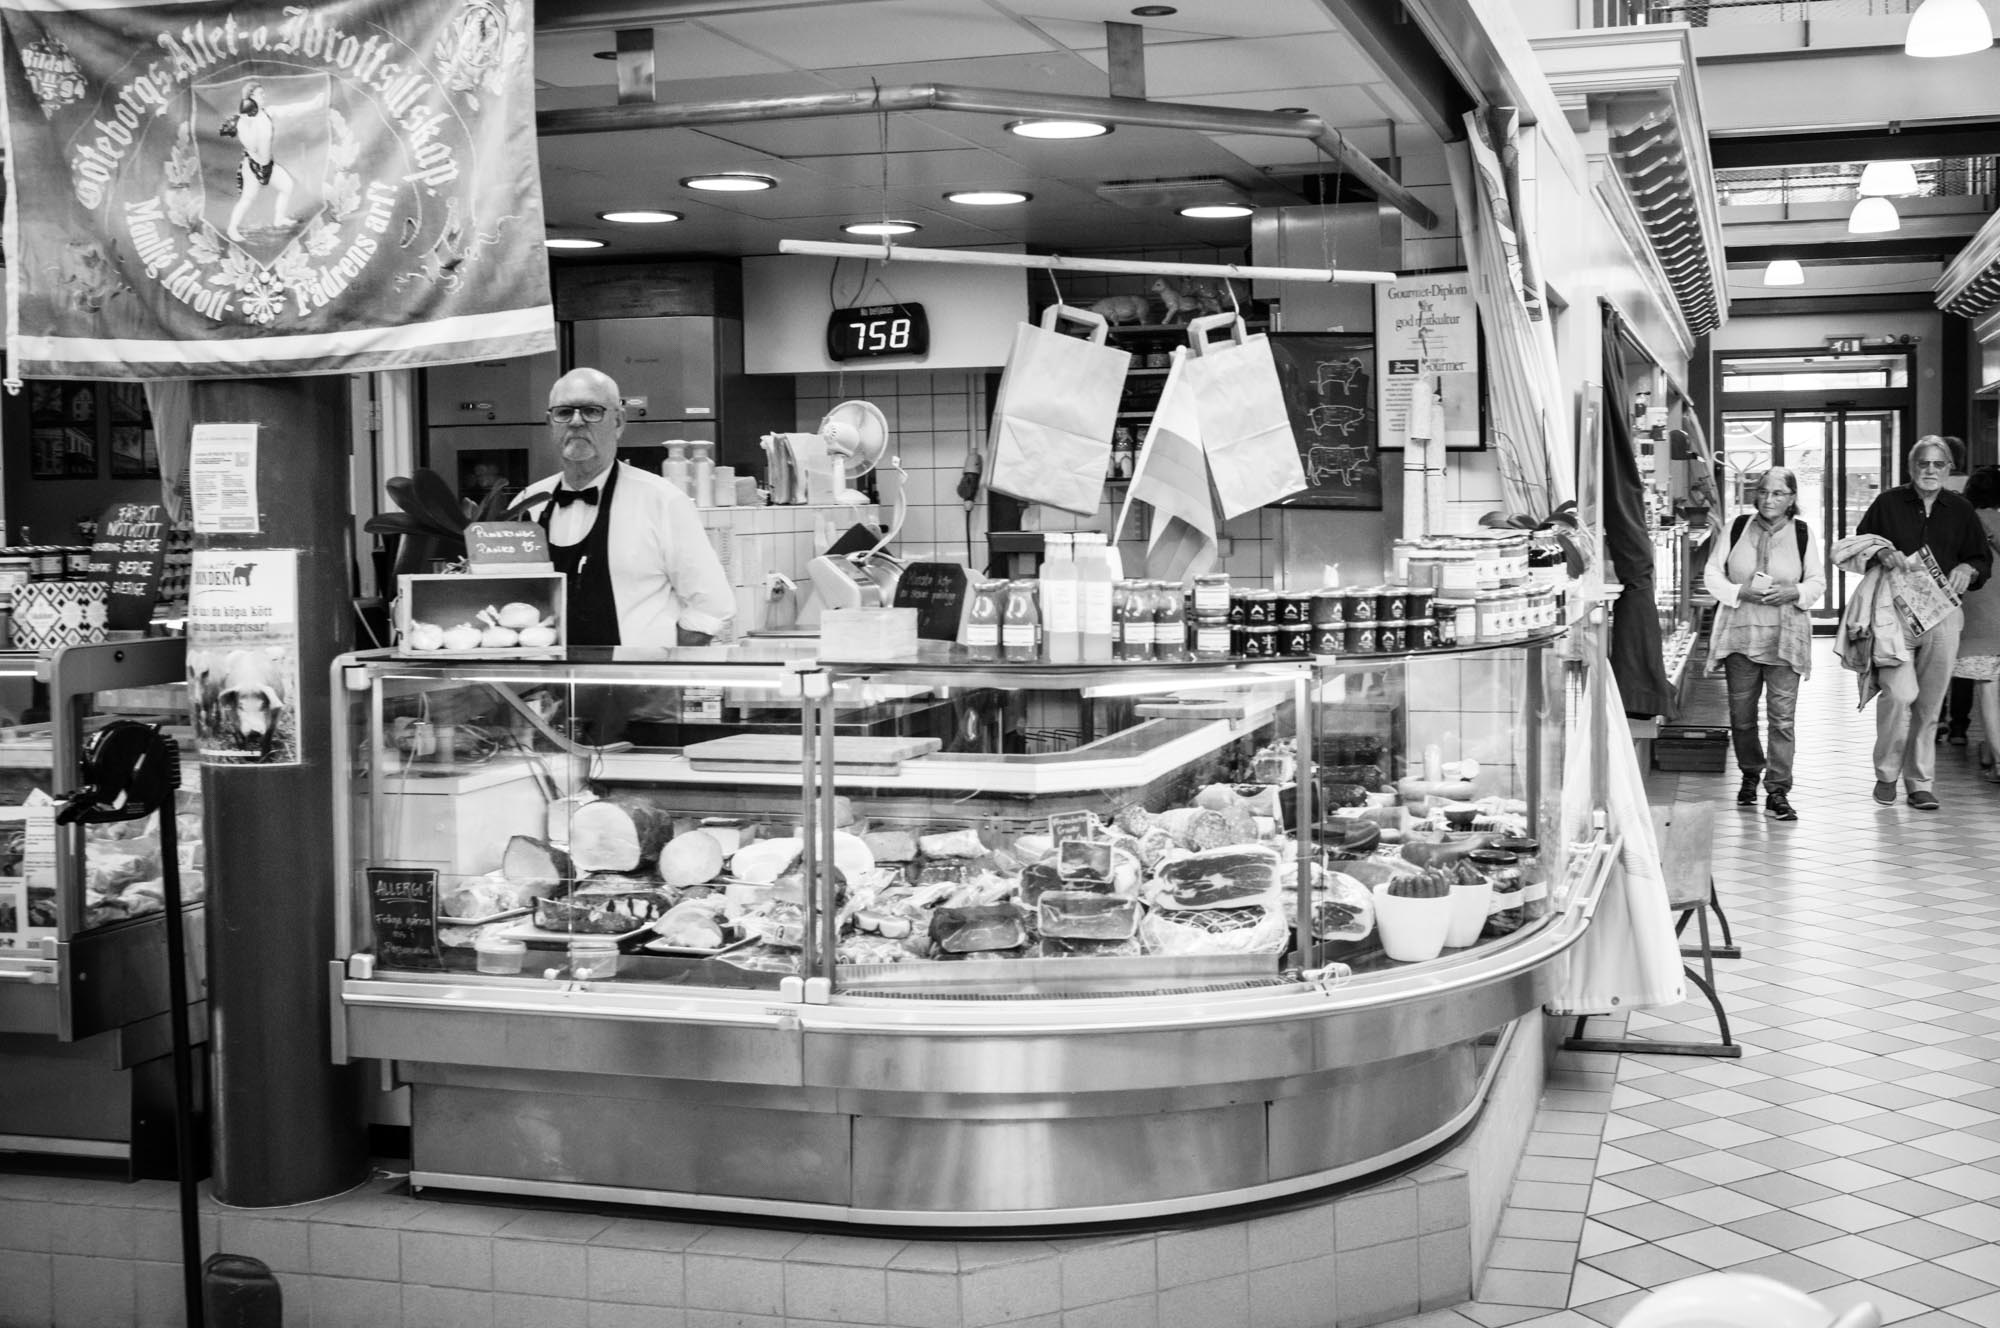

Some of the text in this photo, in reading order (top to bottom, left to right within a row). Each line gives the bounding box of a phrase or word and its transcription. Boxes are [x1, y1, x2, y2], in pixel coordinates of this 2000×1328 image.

[71, 61, 173, 210] Göteborgs
[125, 196, 179, 279] Manlig
[294, 234, 378, 317] Fädrens
[849, 318, 911, 350] 758
[1395, 314, 1414, 332] god
[223, 606, 248, 619] köpa
[250, 605, 273, 617] kött
